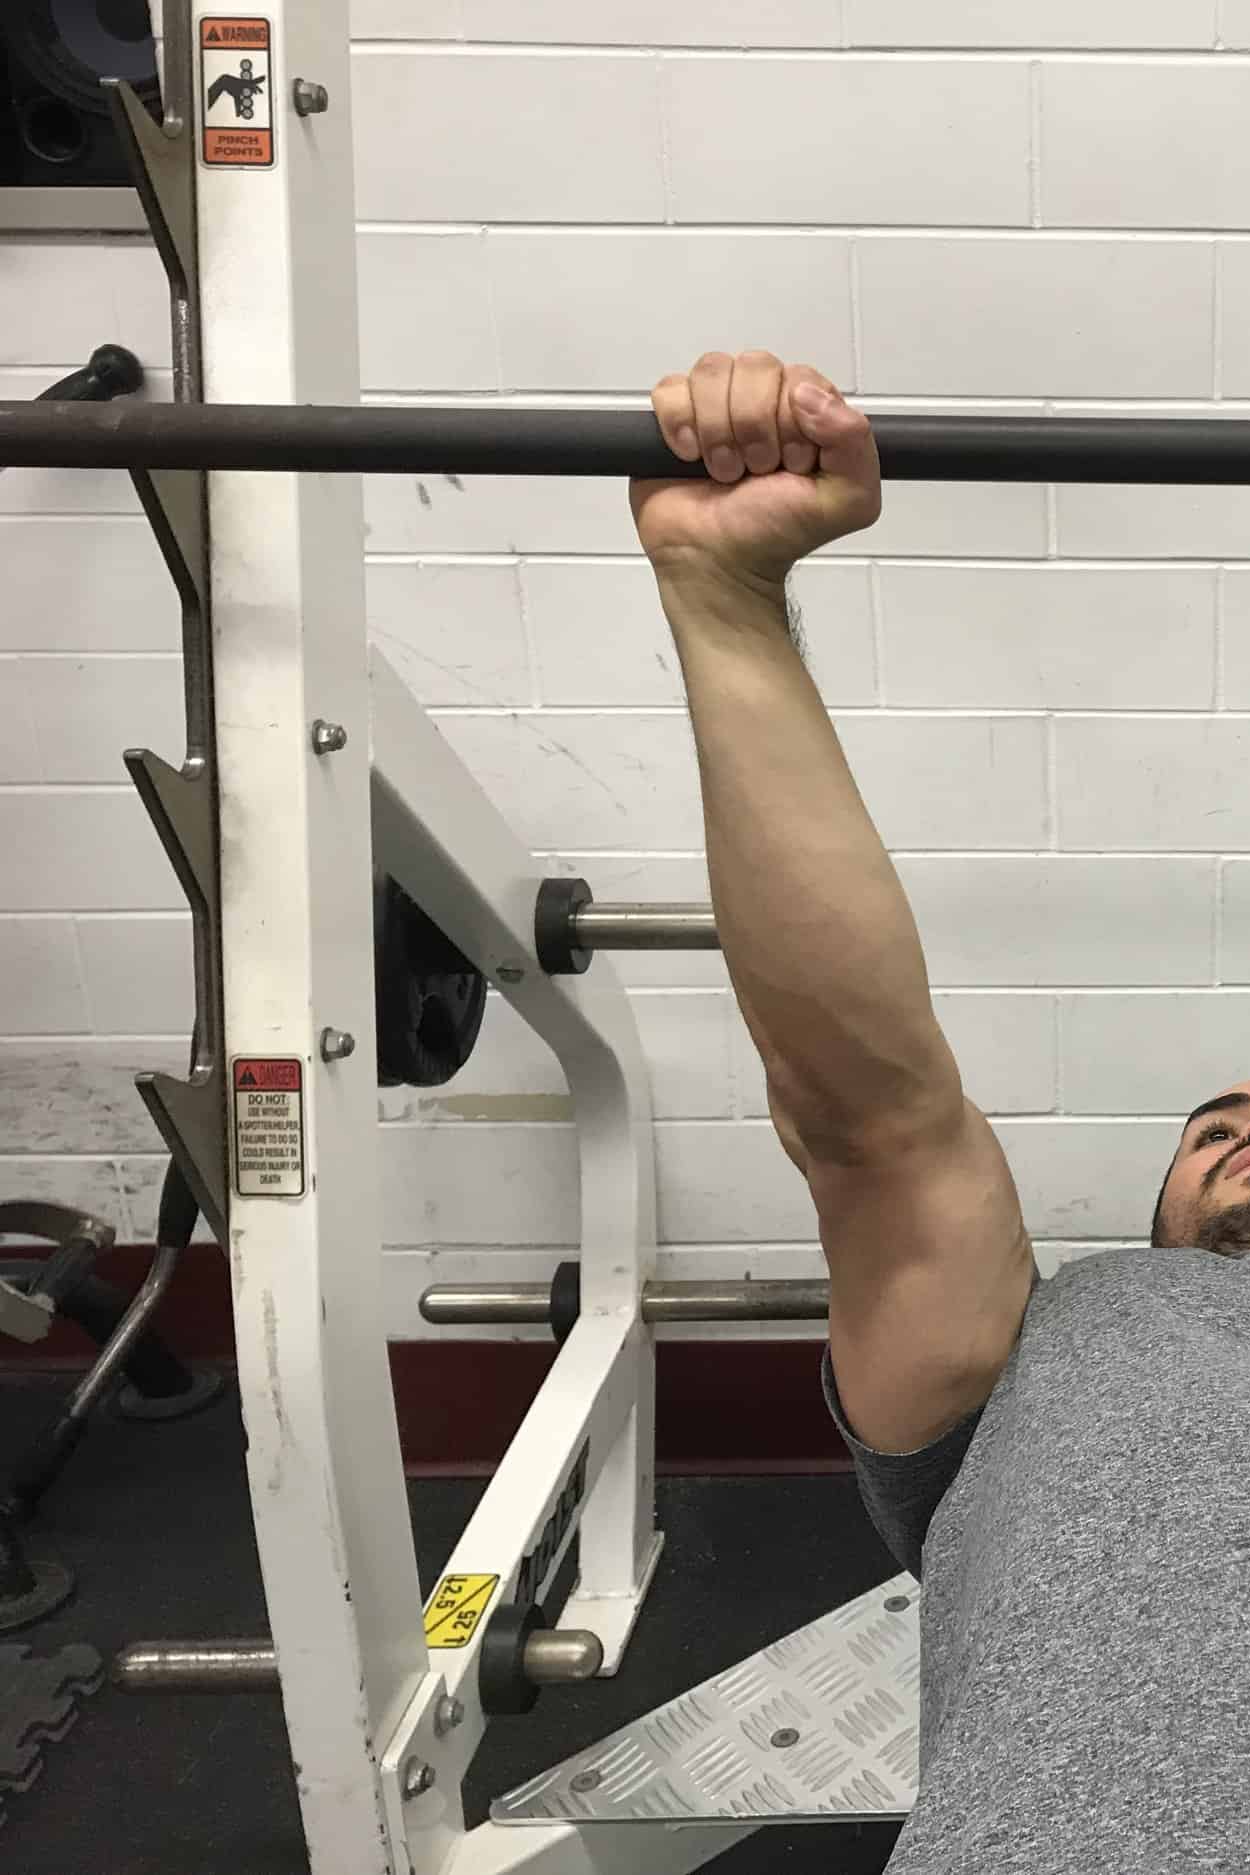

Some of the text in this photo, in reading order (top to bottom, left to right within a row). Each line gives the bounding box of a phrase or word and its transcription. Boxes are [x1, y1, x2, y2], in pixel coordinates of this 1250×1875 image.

[221, 26, 266, 41] WARNING
[217, 135, 259, 145] PINCH
[214, 147, 262, 157] POINTS
[258, 1064, 297, 1086] DANGER
[248, 1094, 263, 1105] DO
[262, 1107, 288, 1117] WITHOUT
[268, 1134, 277, 1144] TO
[260, 1174, 281, 1184] DEATH
